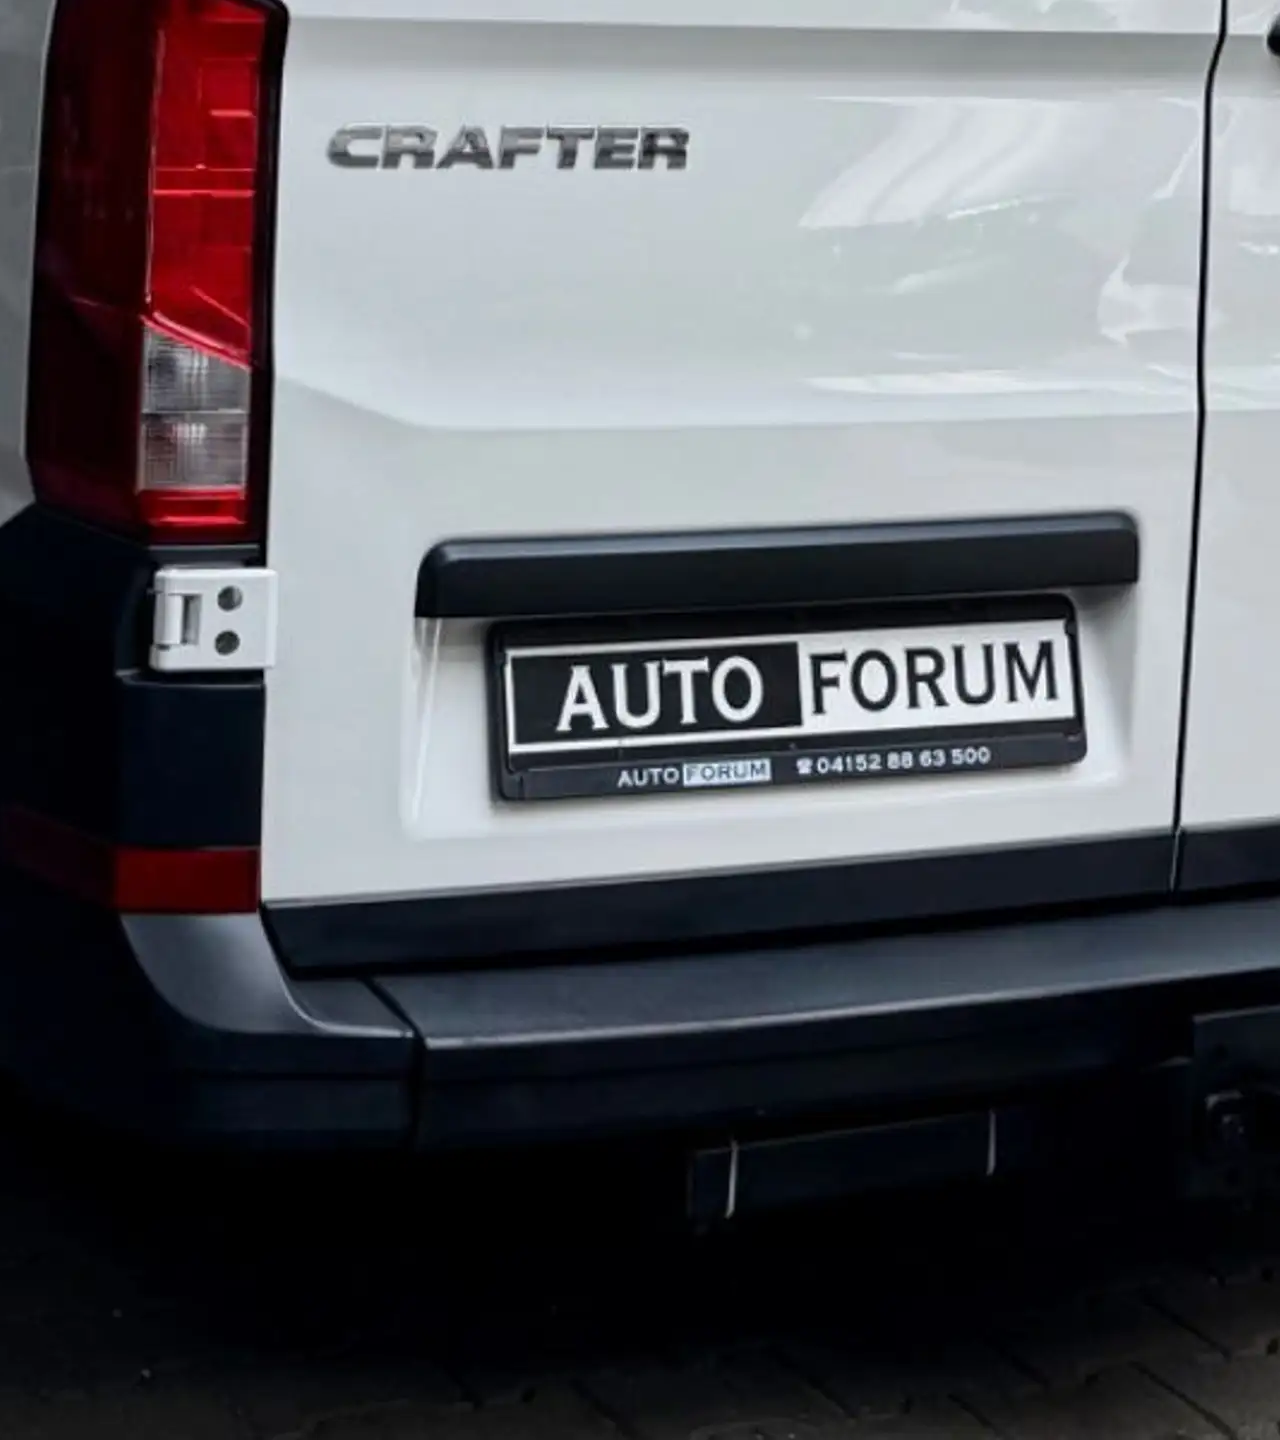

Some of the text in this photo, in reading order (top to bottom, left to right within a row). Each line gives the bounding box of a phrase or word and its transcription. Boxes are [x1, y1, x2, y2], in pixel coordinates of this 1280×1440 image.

[326, 124, 690, 170] CRAFTER
[556, 639, 1058, 732] AUTO FORUM
[617, 761, 768, 789] AUTO FORUM
[816, 746, 991, 774] 04152 88 63 500
